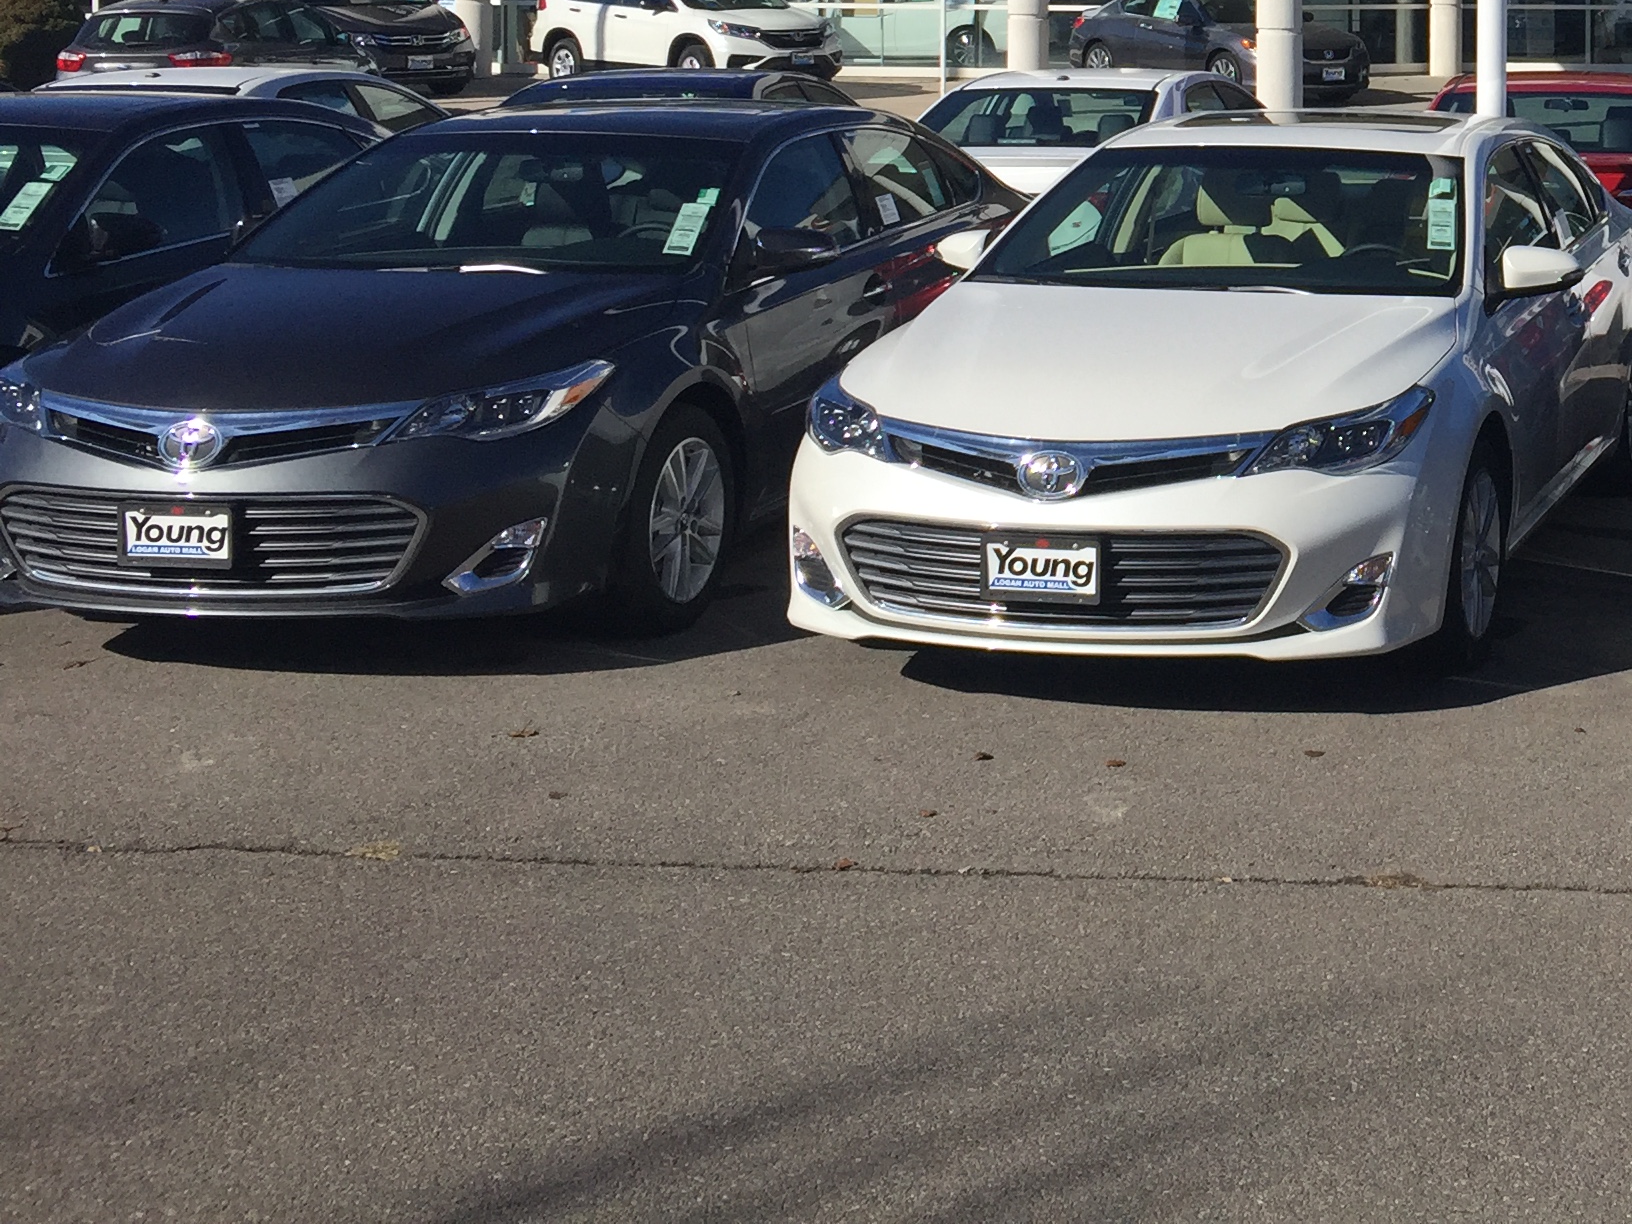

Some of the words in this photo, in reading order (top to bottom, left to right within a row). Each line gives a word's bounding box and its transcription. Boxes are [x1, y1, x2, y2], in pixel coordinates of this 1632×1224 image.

[129, 516, 229, 552] Young
[993, 547, 1095, 588] Young
[994, 579, 1022, 587] LOGAN
[1023, 580, 1045, 588] AUTO
[1047, 581, 1070, 589] MALL
